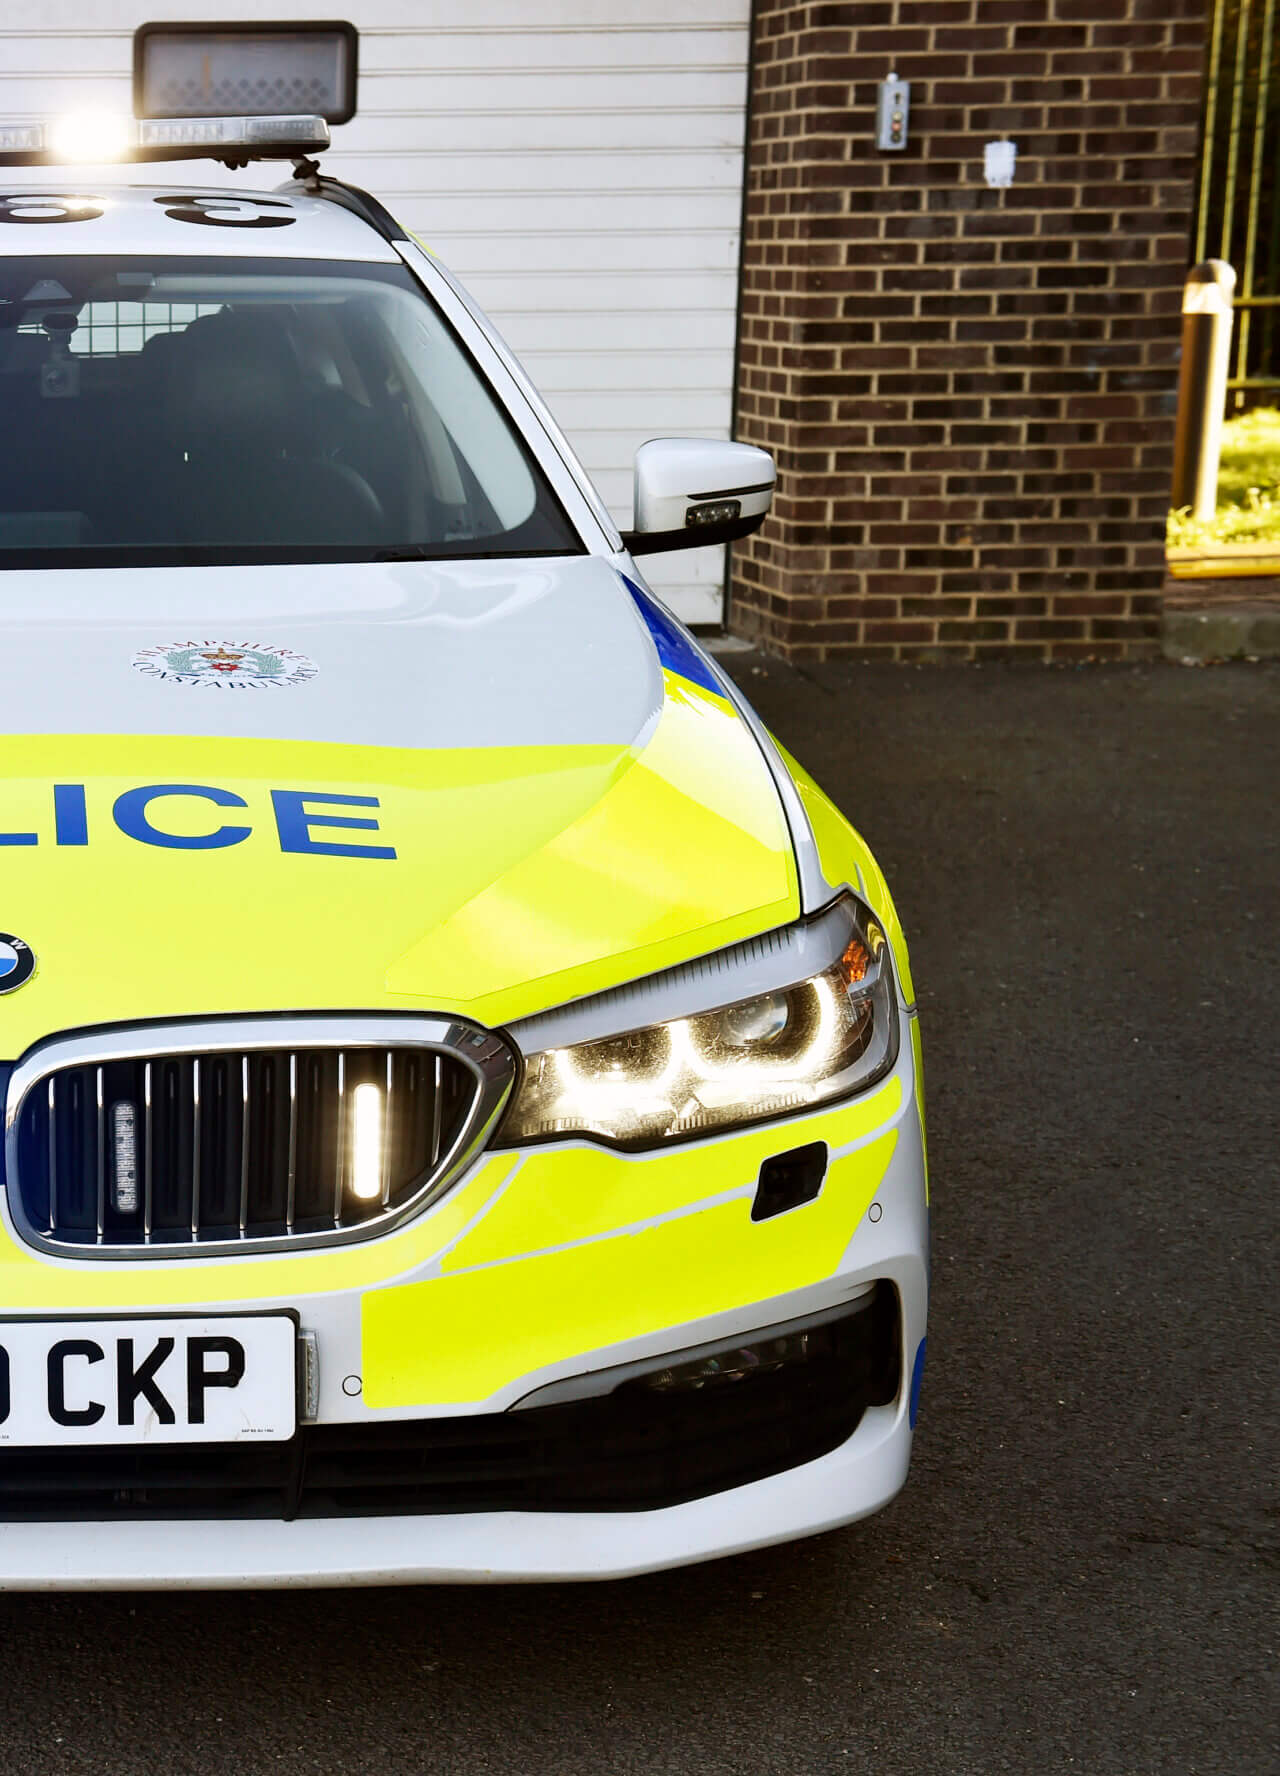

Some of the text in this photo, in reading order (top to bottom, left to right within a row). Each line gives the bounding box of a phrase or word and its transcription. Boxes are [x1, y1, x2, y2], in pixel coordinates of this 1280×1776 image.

[135, 641, 309, 661] HAMPSHIRE
[132, 661, 319, 689] CONSTABULARY
[46, 1336, 246, 1426] CKP
